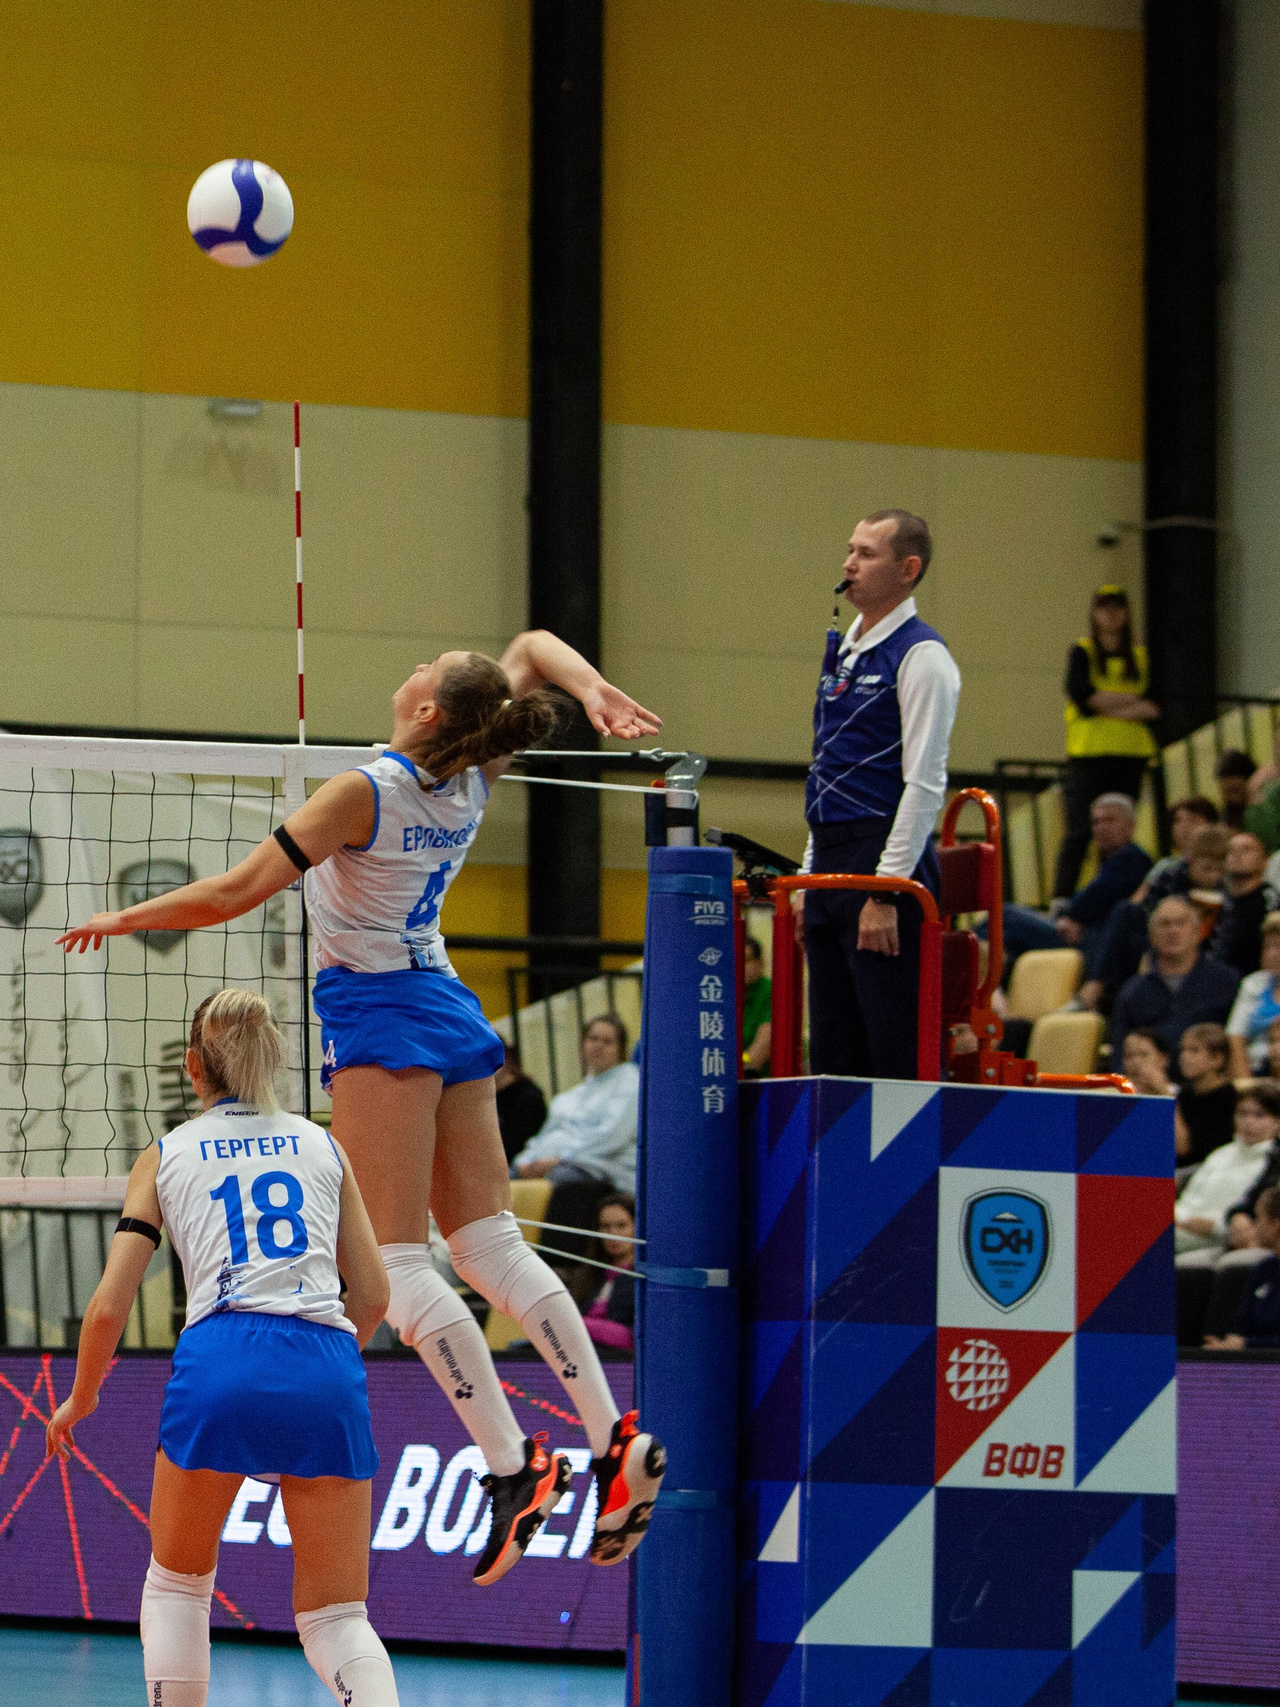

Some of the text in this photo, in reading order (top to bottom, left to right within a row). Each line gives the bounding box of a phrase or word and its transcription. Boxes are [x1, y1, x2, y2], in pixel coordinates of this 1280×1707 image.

[694, 901, 725, 914] FIVB
[199, 1135, 300, 1161] ГЕРГЕРТ
[209, 1170, 309, 1266] 18
[982, 1442, 1065, 1480] ВФВ
